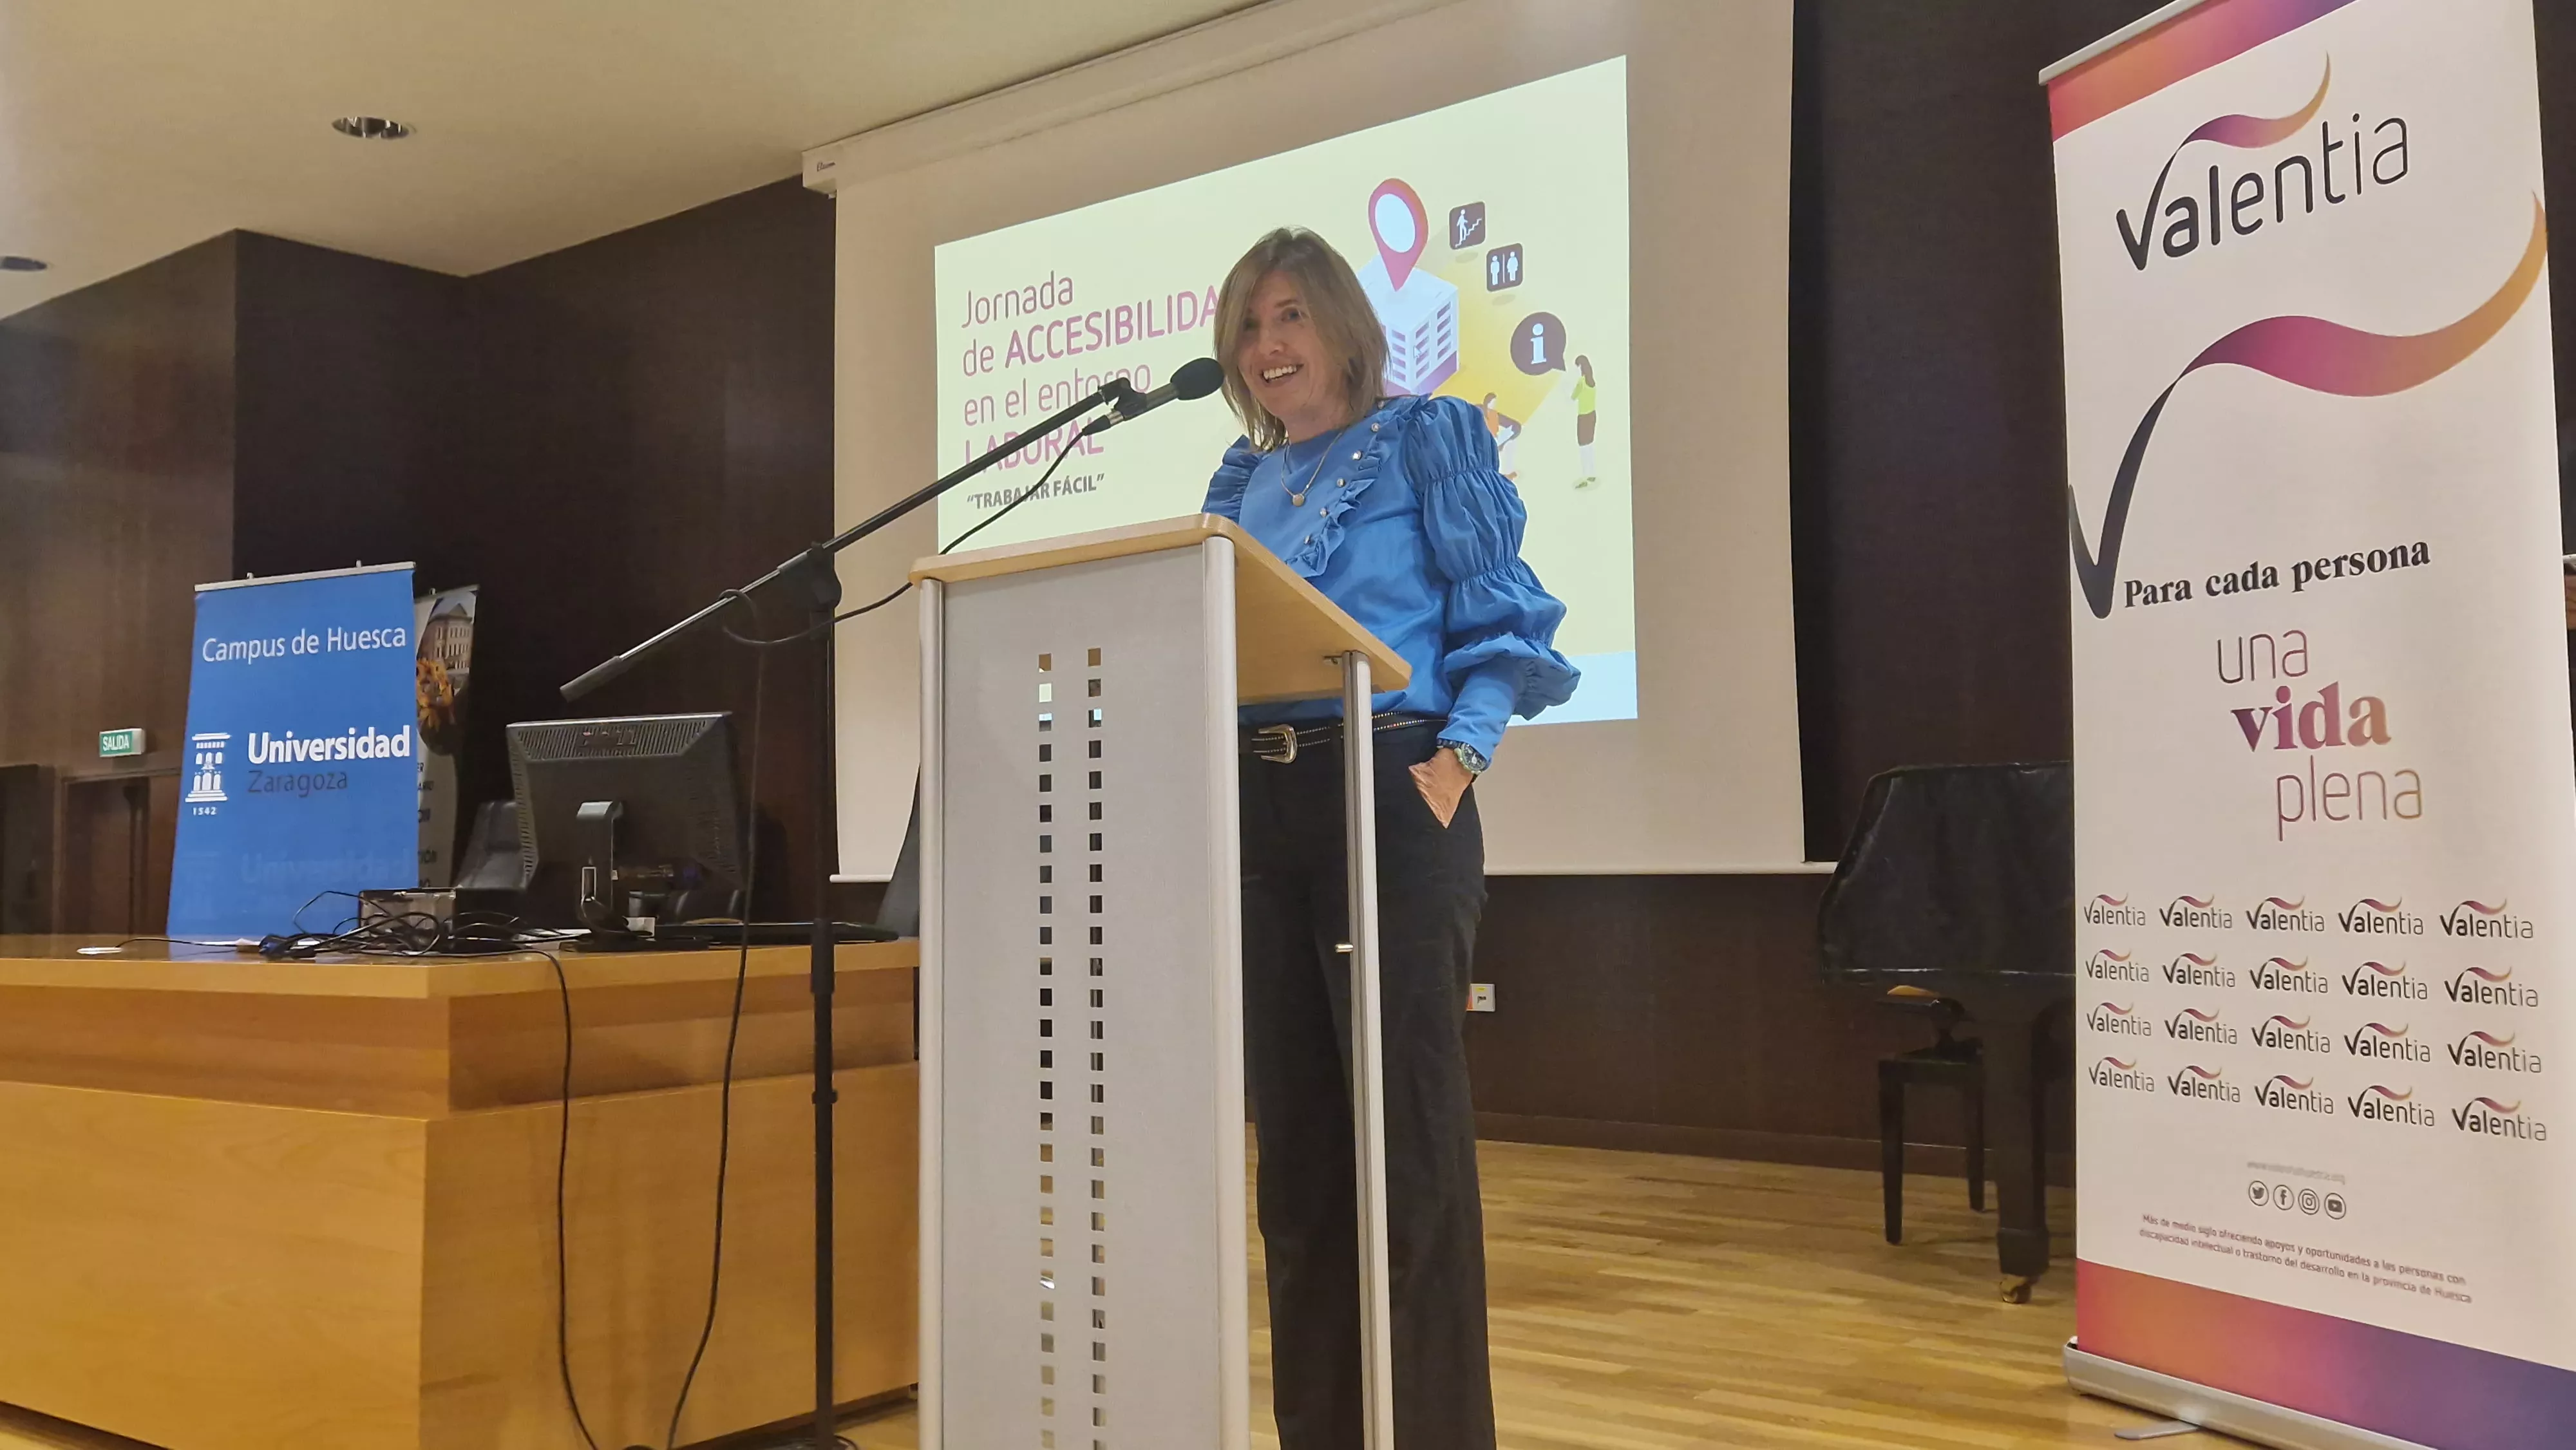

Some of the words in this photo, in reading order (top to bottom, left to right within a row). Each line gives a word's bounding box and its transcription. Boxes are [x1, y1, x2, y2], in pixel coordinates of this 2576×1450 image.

[2116, 113, 2408, 270] Valentia
[961, 270, 1073, 328] Jornada
[963, 339, 994, 376] de
[1005, 285, 1219, 368] ACCESIBILIDA
[965, 395, 994, 426] en
[1006, 377, 1026, 417] el
[2125, 578, 2192, 608] Para
[2206, 561, 2279, 596] cada
[2291, 541, 2430, 592] persona
[203, 636, 285, 664] Campus
[292, 628, 319, 655] de
[328, 626, 406, 652] Huesca
[2217, 630, 2308, 683] una
[2231, 681, 2391, 751] vida
[103, 735, 129, 751] SALIDA
[248, 726, 410, 764] Universidad
[247, 770, 347, 798] Zaragoza
[2277, 755, 2422, 842] plena
[193, 806, 217, 816] 1542
[2084, 898, 2146, 926] Valentia
[2160, 899, 2233, 930] Valentia
[2246, 901, 2325, 932] Valentia
[2338, 902, 2424, 936] Valentia
[2440, 905, 2533, 939] Valentia
[2086, 953, 2149, 983] Valentia
[2163, 957, 2235, 988] Valentia
[2250, 961, 2329, 994] Valentia
[2342, 966, 2428, 1000] Valentia
[2445, 971, 2539, 1008] Valentia
[2087, 1006, 2152, 1037] Valentia
[2164, 1012, 2237, 1044] Valentia
[2251, 1019, 2331, 1054] Valentia
[2344, 1026, 2430, 1063] Valentia
[2448, 1035, 2542, 1073] Valentia
[2088, 1060, 2155, 1092] Valentia
[2168, 1069, 2240, 1102] Valentia
[2255, 1078, 2334, 1115] Valentia
[2348, 1089, 2435, 1127] Valentia
[2452, 1101, 2546, 1141] Valentia
[2285, 1256, 2298, 1267] del
[2298, 1246, 2304, 1256] y
[2306, 1247, 2371, 1266] oportunidades
